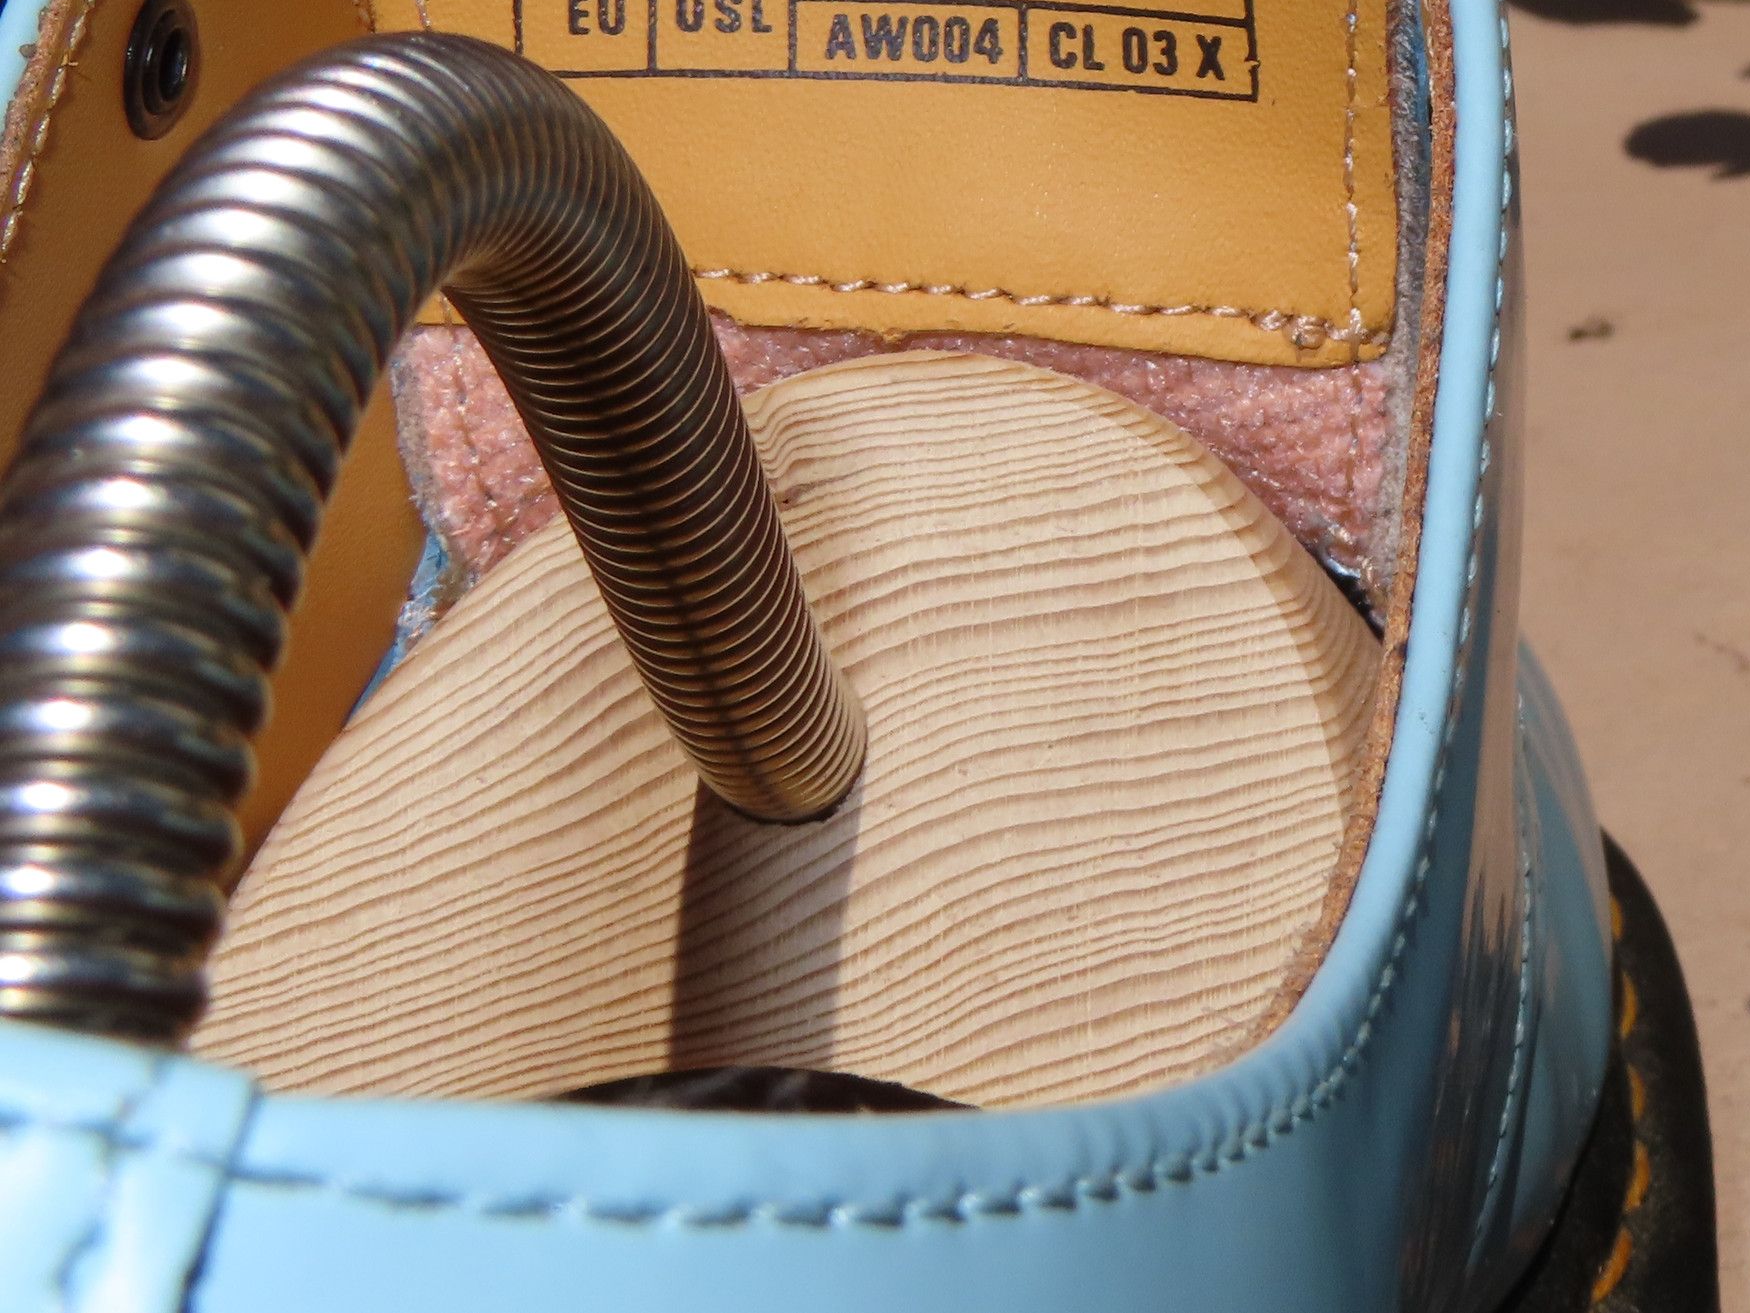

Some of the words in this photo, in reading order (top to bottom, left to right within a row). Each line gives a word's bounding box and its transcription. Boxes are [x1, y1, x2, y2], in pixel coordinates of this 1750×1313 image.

[825, 13, 1003, 64] AW004
[1049, 21, 1105, 71] CL
[1122, 27, 1178, 76] 03
[1196, 33, 1225, 81] X
